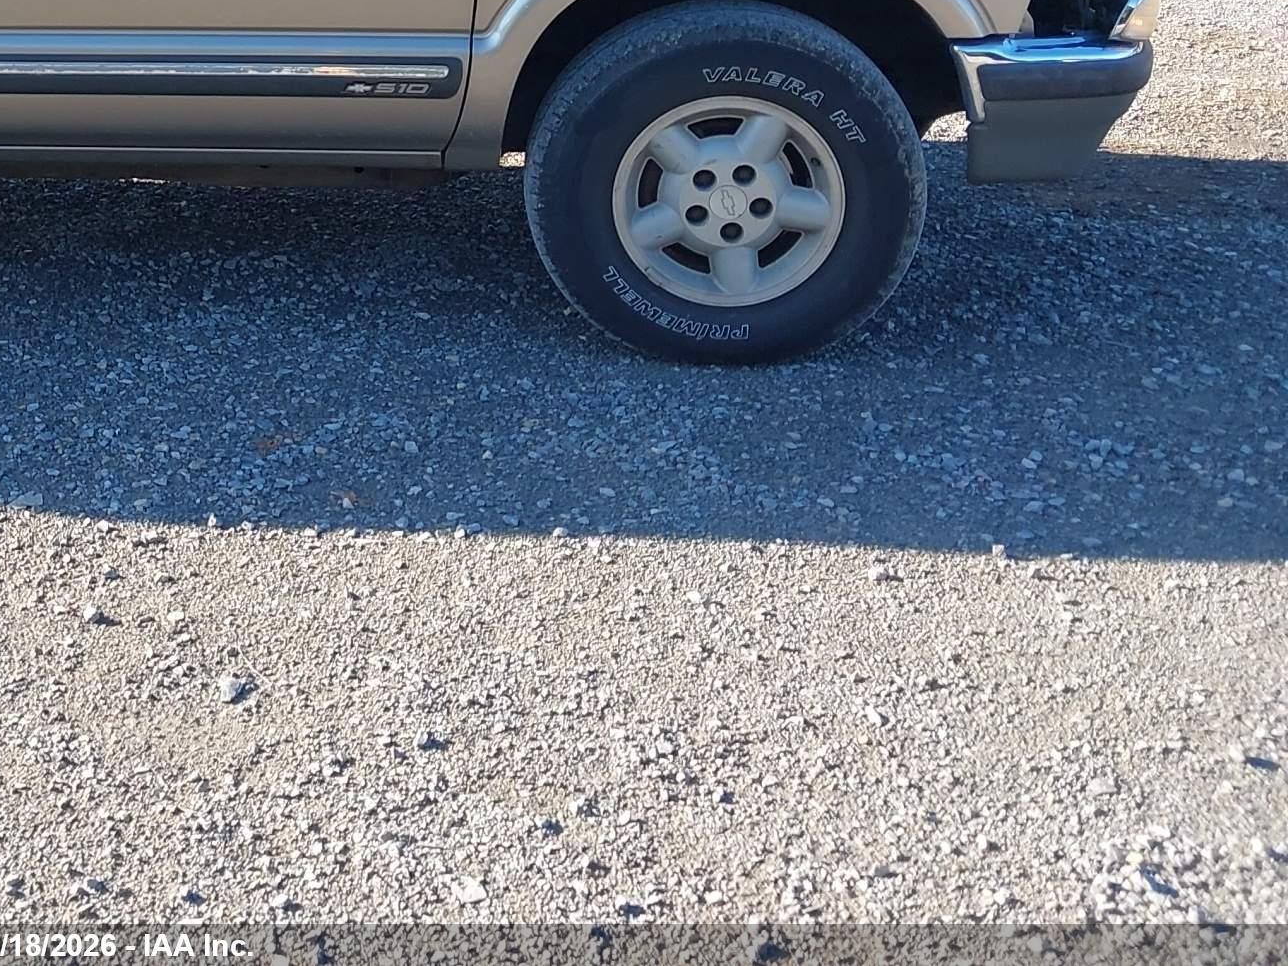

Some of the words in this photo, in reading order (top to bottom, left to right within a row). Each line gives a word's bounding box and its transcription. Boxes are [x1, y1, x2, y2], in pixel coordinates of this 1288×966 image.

[374, 82, 430, 94] S10
[702, 66, 825, 108] VALERA
[829, 109, 866, 144] HT
[602, 265, 750, 340] PRIMEWELL
